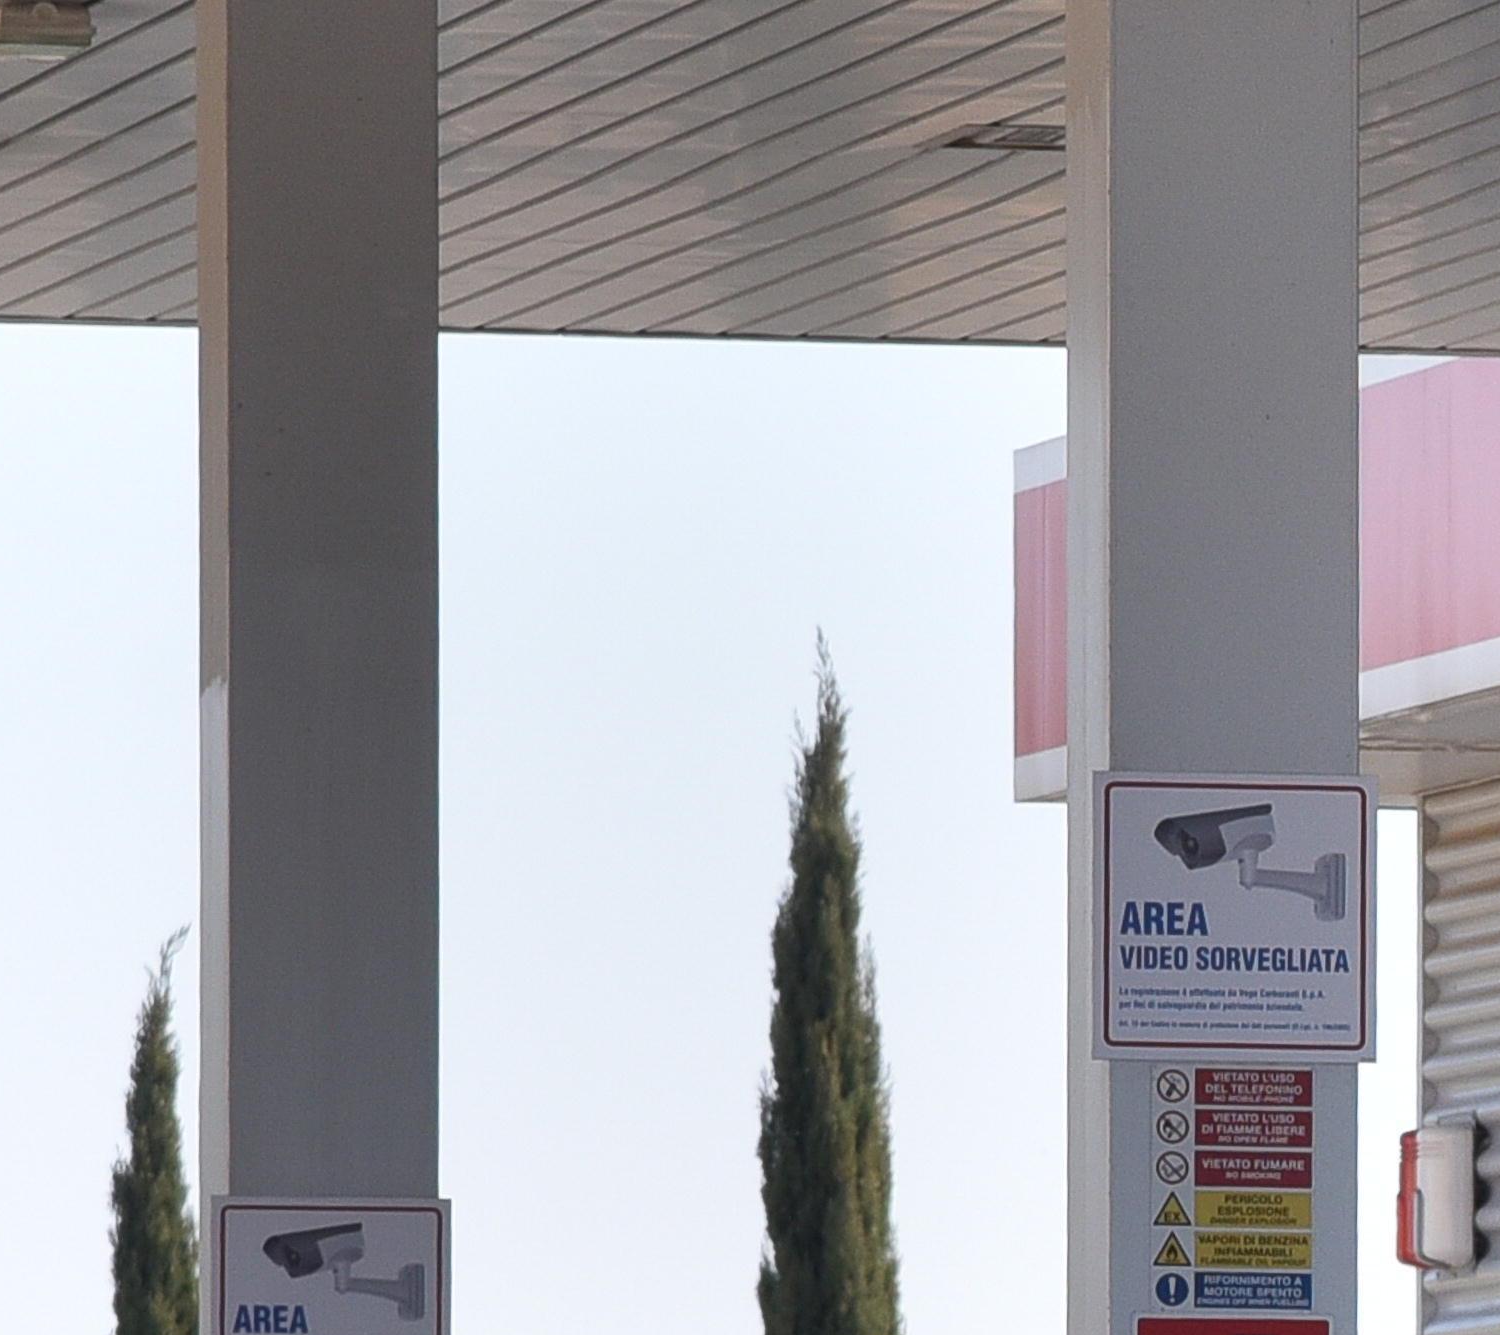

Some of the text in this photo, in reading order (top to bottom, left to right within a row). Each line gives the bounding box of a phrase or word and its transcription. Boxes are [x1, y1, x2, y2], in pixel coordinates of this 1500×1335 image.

[1120, 901, 1208, 936] AREA
[1120, 945, 1350, 974] VIDEO SORVEGLIATA
[1213, 1072, 1295, 1083] VIETATO L'USO
[1205, 1084, 1303, 1095] DEL TELEFONINO
[1212, 1113, 1295, 1123] VIETATO L'USO
[1202, 1124, 1306, 1136] DI FIAMME LIBERE
[1202, 1159, 1305, 1170] VIETATO FUMARE
[1224, 1194, 1283, 1204] PERICOLO
[1218, 1206, 1289, 1216] ESPLOSIONE
[1258, 1236, 1308, 1246] BENZINA
[1204, 1275, 1302, 1286] RIFORNIMENTO A
[1204, 1287, 1302, 1298] MOTORE SPENTO
[233, 1305, 308, 1334] AREA
